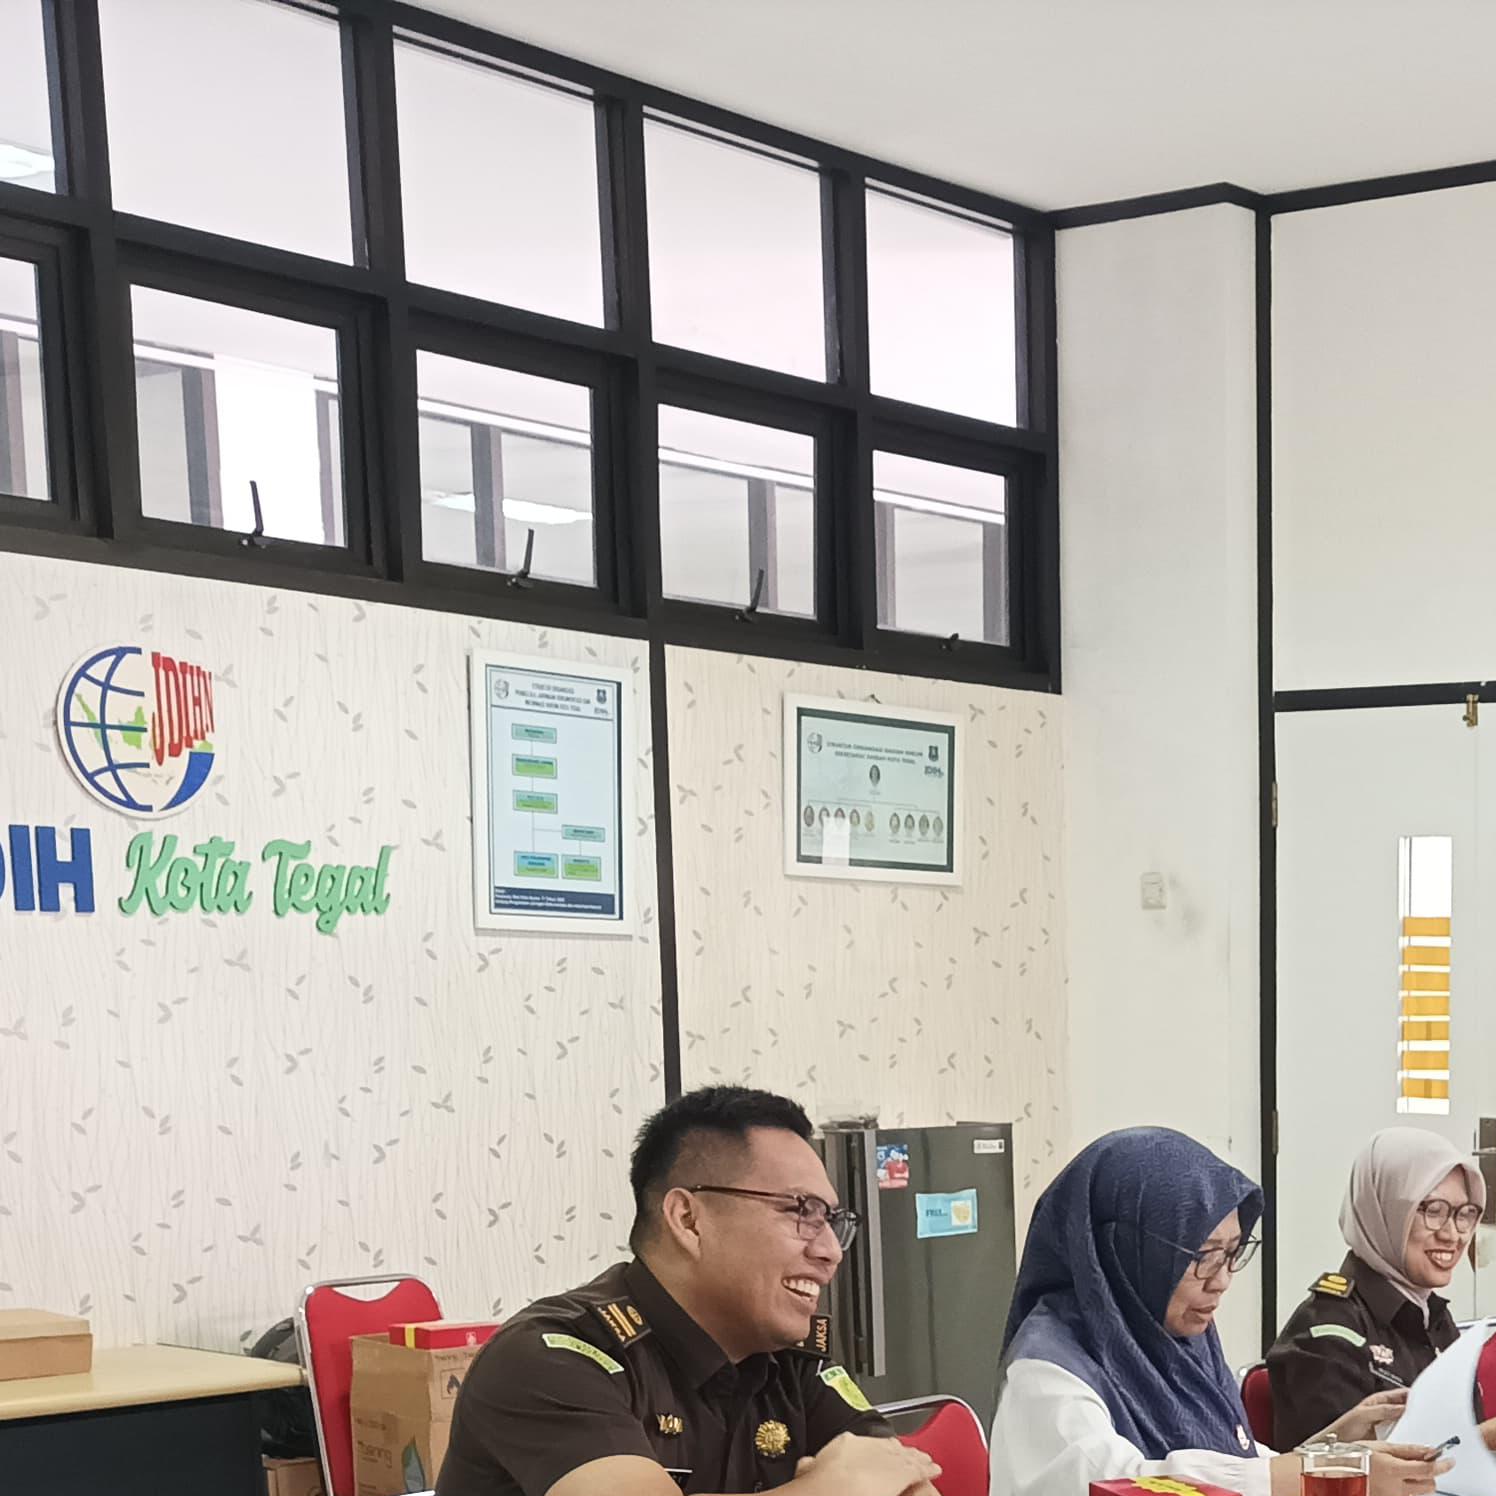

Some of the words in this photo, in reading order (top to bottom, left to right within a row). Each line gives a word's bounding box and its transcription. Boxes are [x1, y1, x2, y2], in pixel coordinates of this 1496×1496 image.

[0, 824, 95, 913] IH
[118, 831, 253, 917] Kota
[262, 839, 392, 934] Tegal
[815, 1319, 828, 1352] JAKSA
